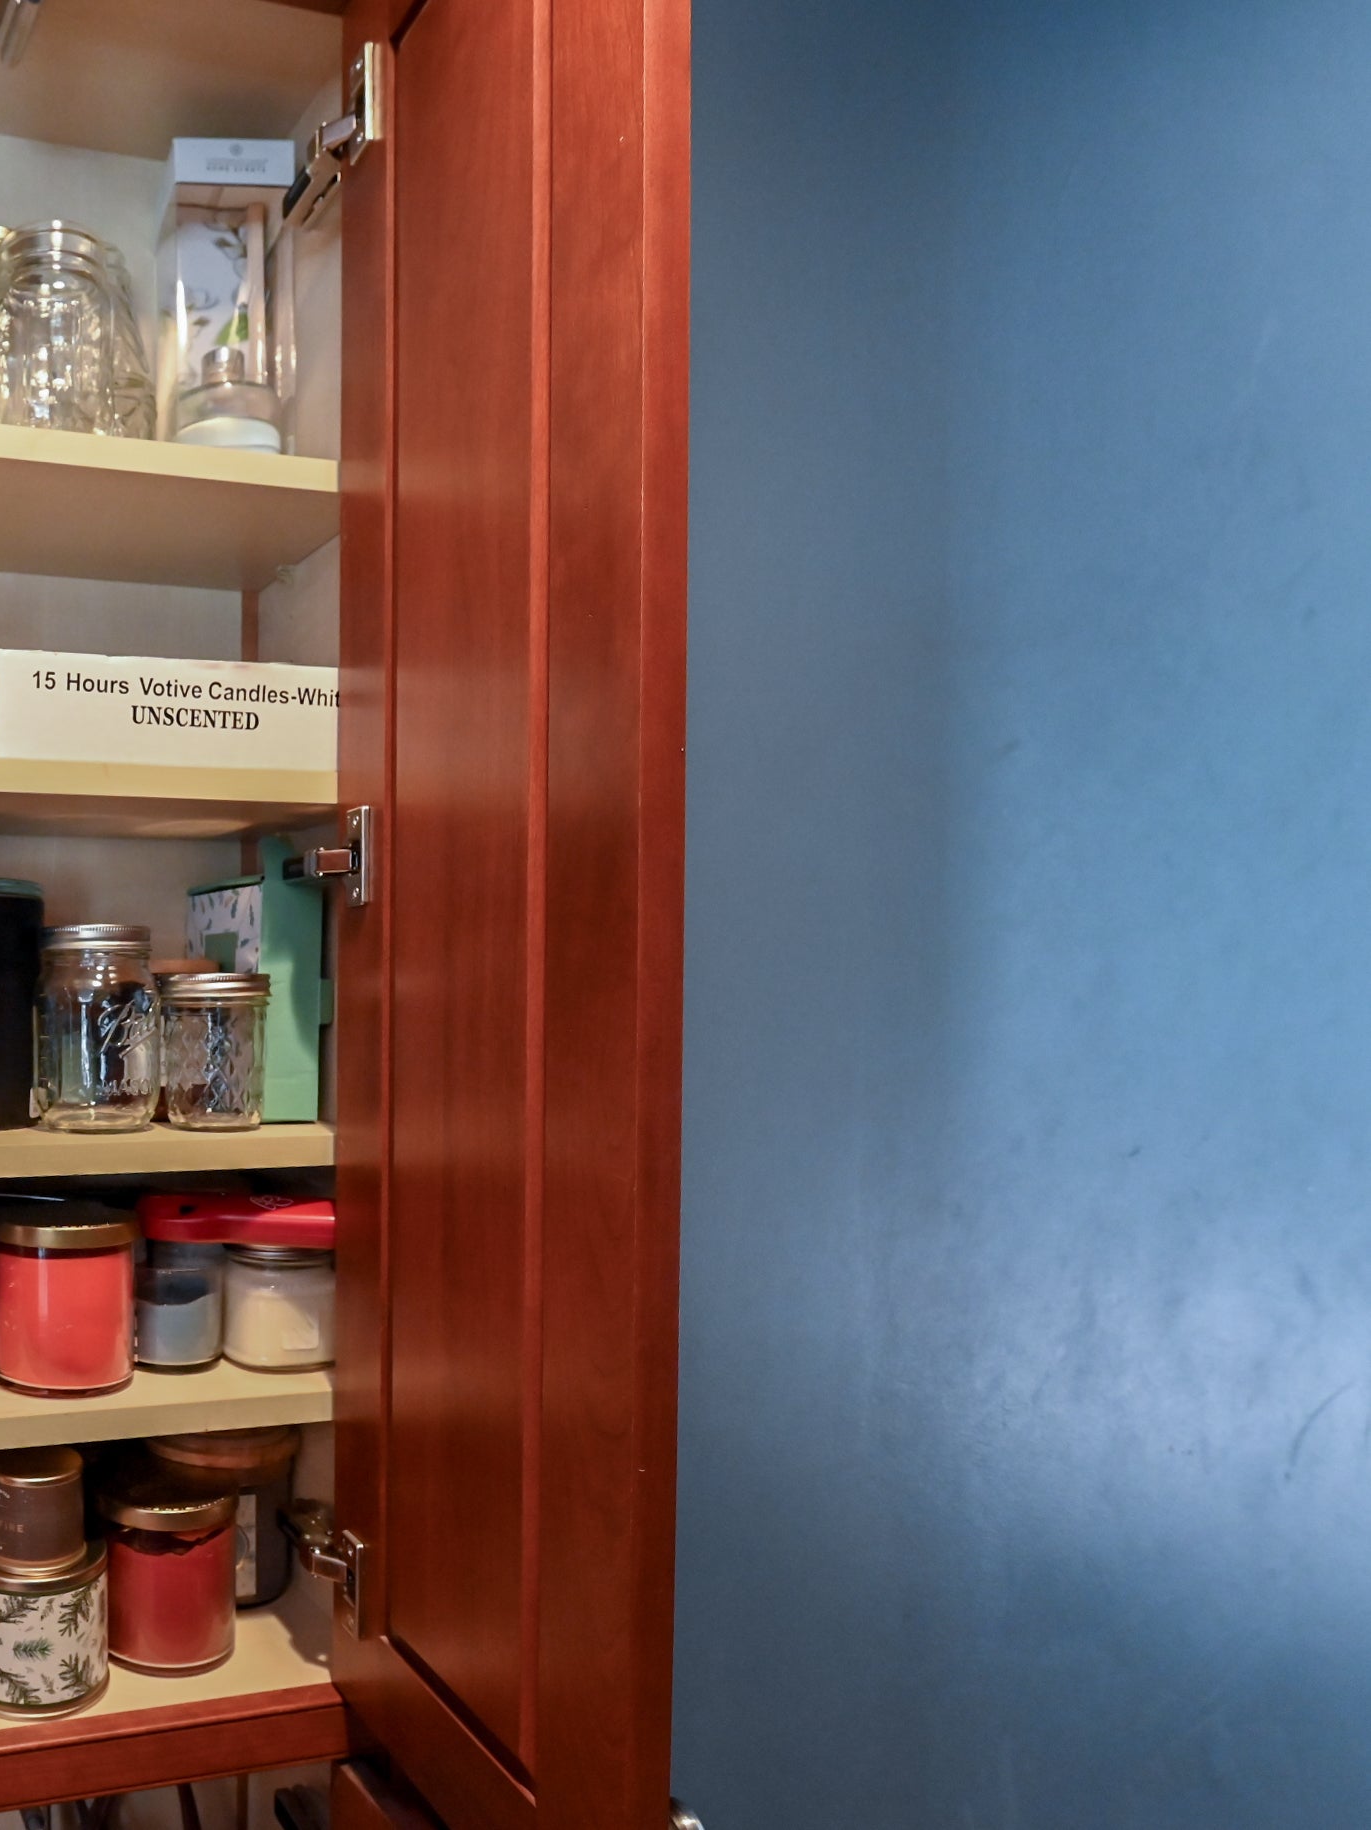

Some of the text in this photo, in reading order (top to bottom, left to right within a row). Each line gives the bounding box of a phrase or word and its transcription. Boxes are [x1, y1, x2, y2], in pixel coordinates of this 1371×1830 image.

[32, 670, 56, 690] 15
[66, 672, 129, 694] Hours
[139, 677, 203, 699] Votive
[131, 705, 260, 731] UNSCENTED
